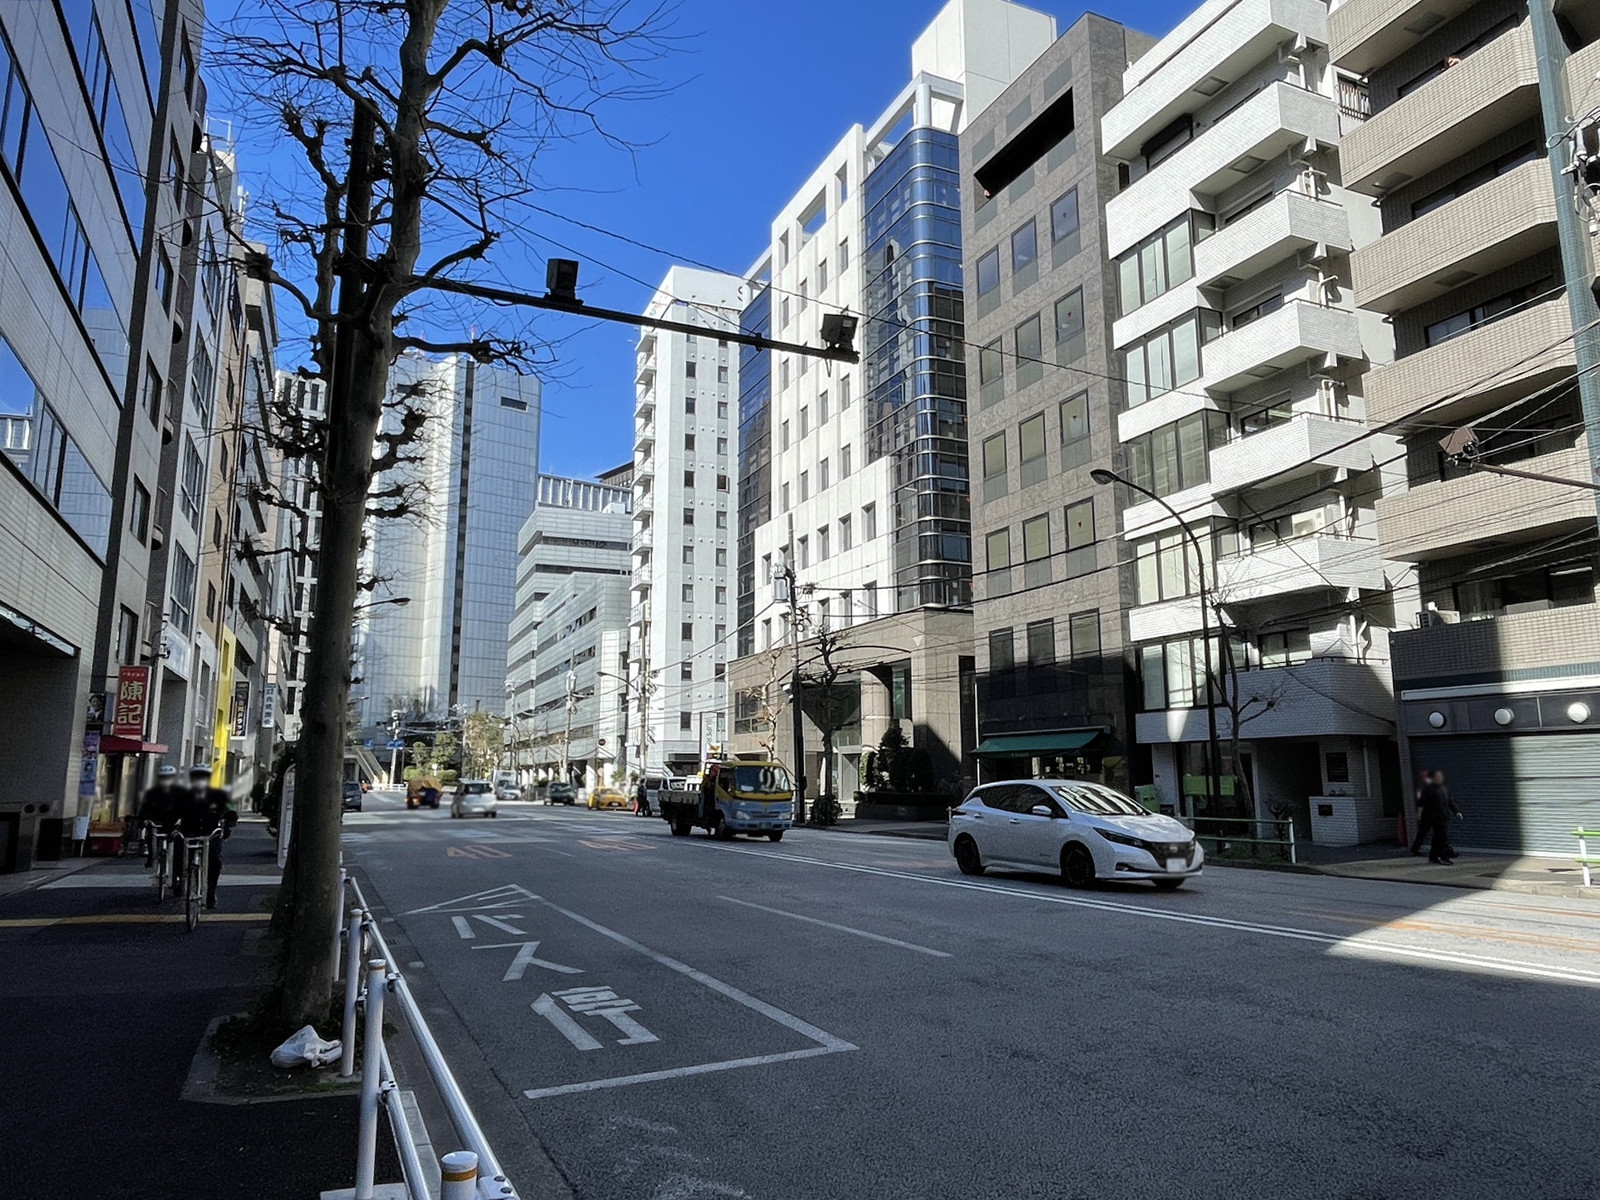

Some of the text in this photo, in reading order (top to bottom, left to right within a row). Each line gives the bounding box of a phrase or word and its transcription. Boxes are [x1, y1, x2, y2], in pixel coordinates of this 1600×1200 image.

[117, 681, 143, 724] 陳記
[446, 844, 513, 859] 40
[451, 914, 659, 1051] バス停
